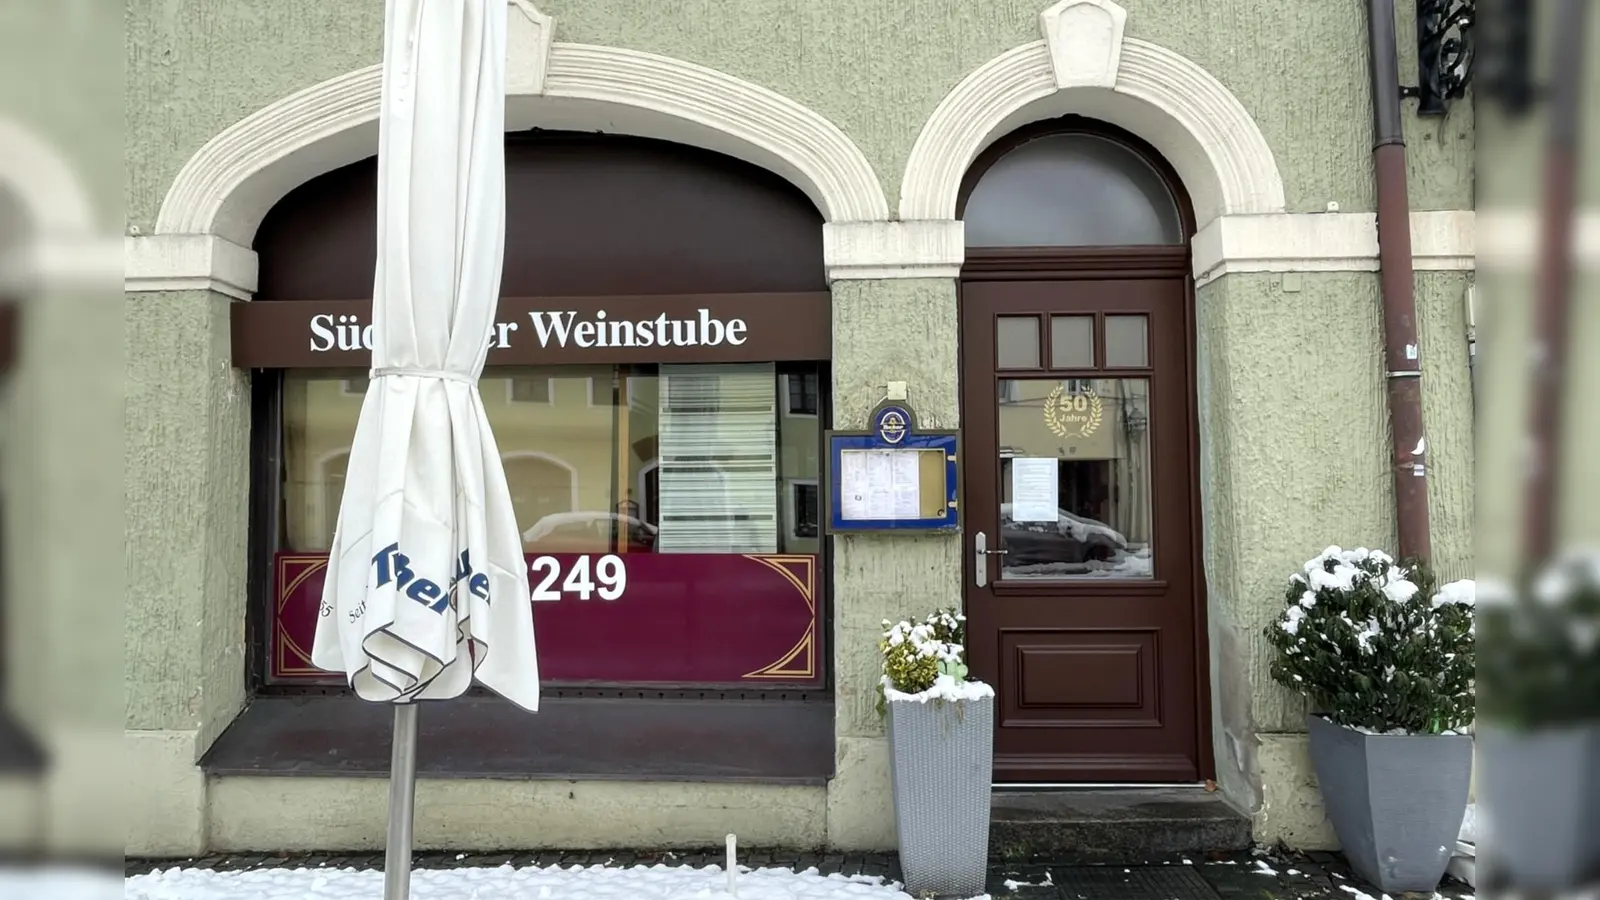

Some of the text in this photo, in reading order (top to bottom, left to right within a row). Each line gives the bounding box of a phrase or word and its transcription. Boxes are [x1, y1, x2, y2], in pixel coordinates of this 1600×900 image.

[528, 308, 748, 348] Weinstube
[1059, 395, 1087, 412] 50
[1059, 414, 1087, 424] Jahre
[531, 554, 627, 601] 249
